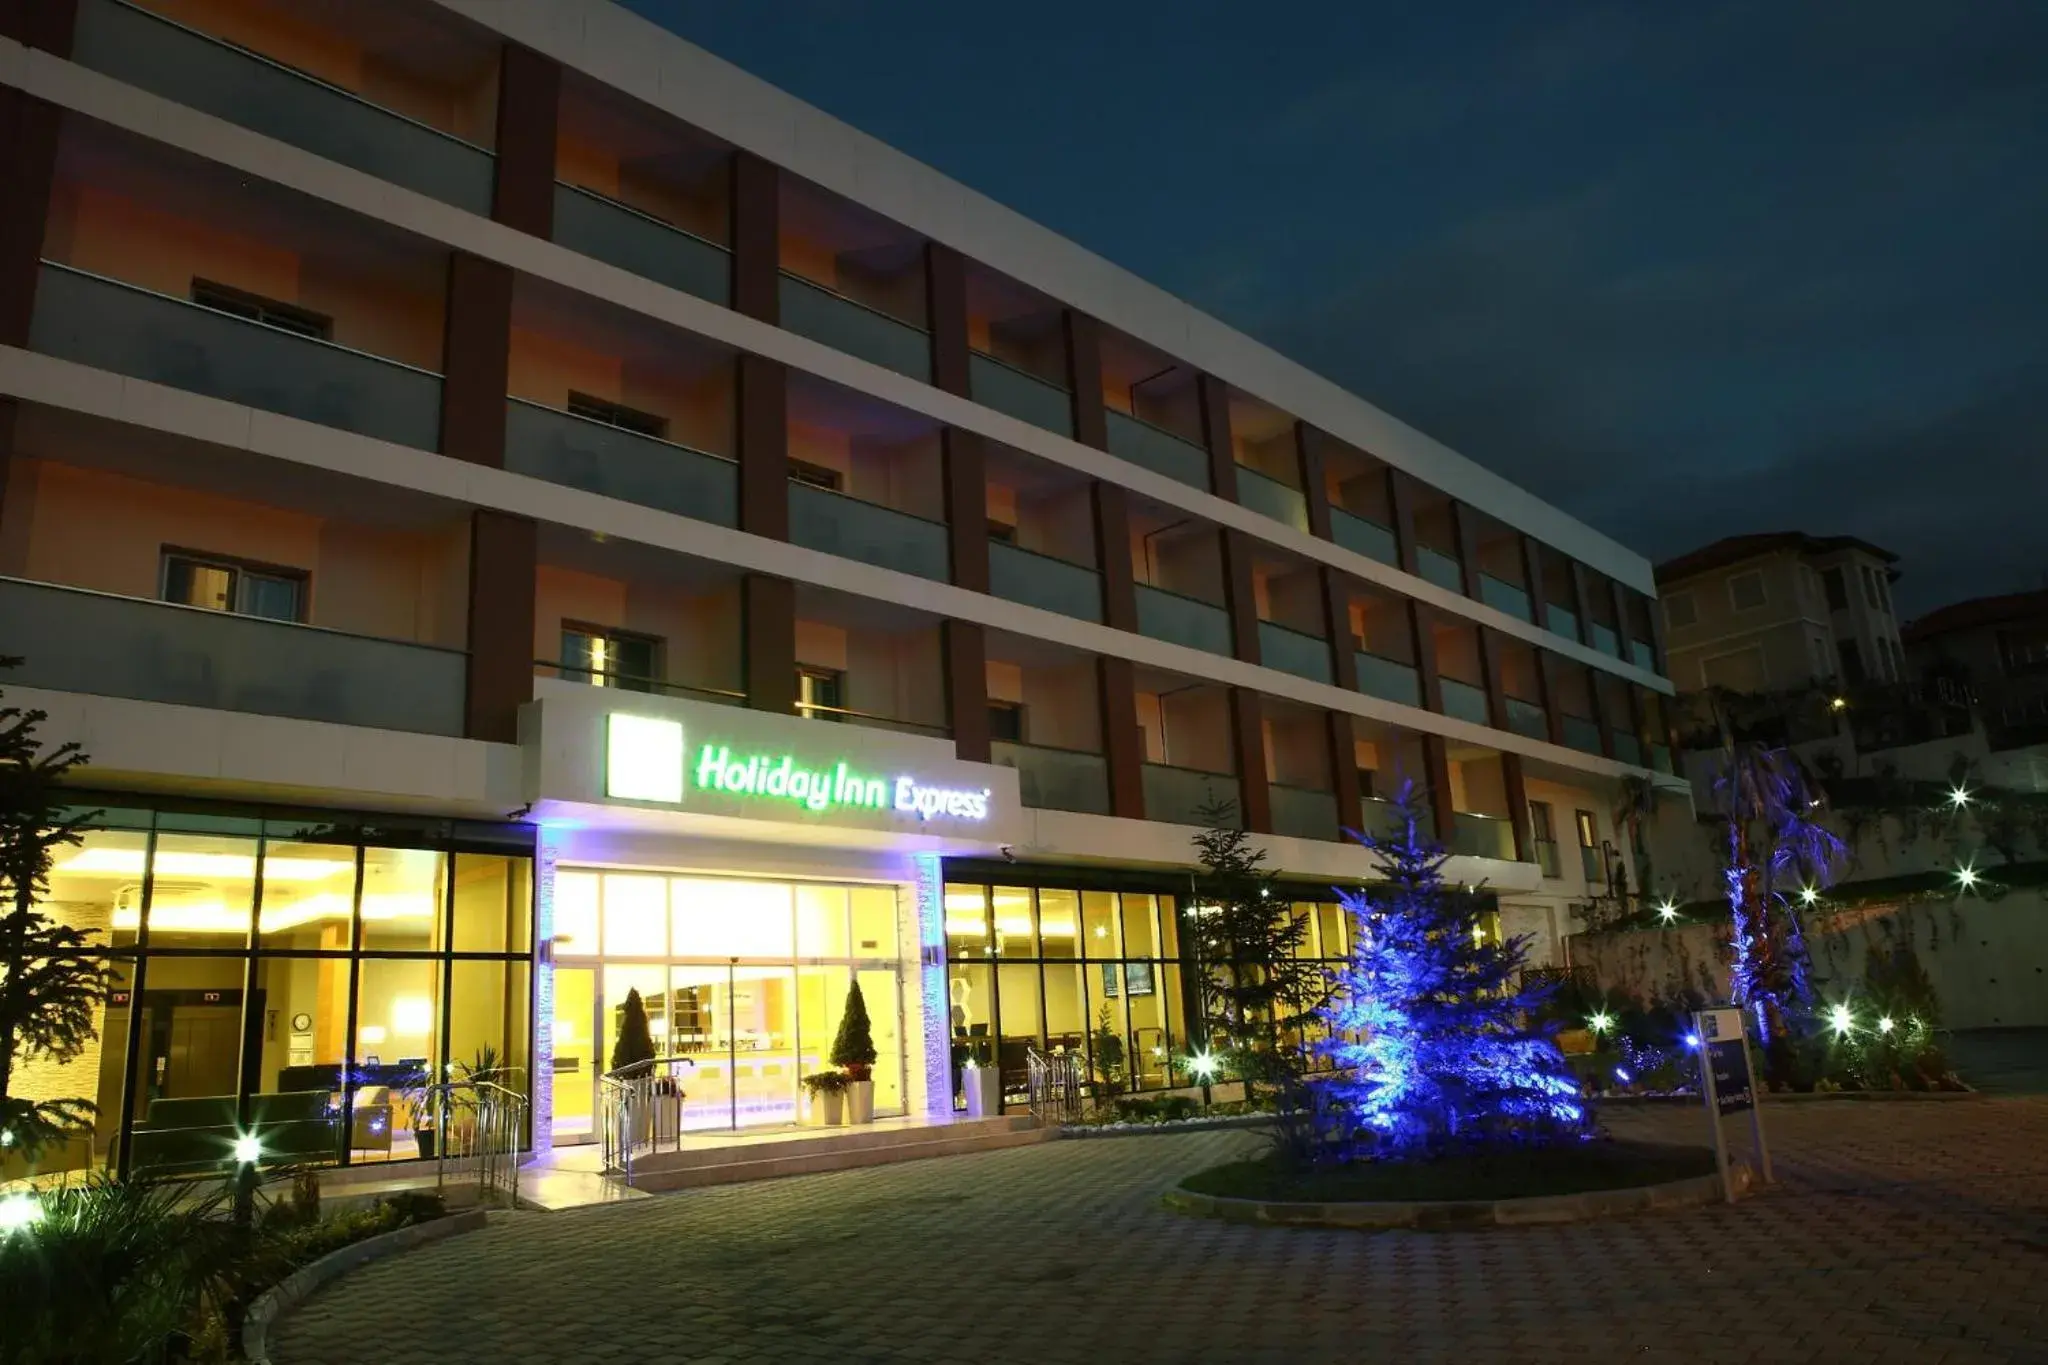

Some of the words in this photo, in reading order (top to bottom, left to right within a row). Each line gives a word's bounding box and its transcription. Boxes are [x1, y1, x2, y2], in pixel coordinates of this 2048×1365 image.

[697, 744, 830, 809] Holiday
[834, 763, 886, 807] Inn
[894, 777, 989, 819] Express
